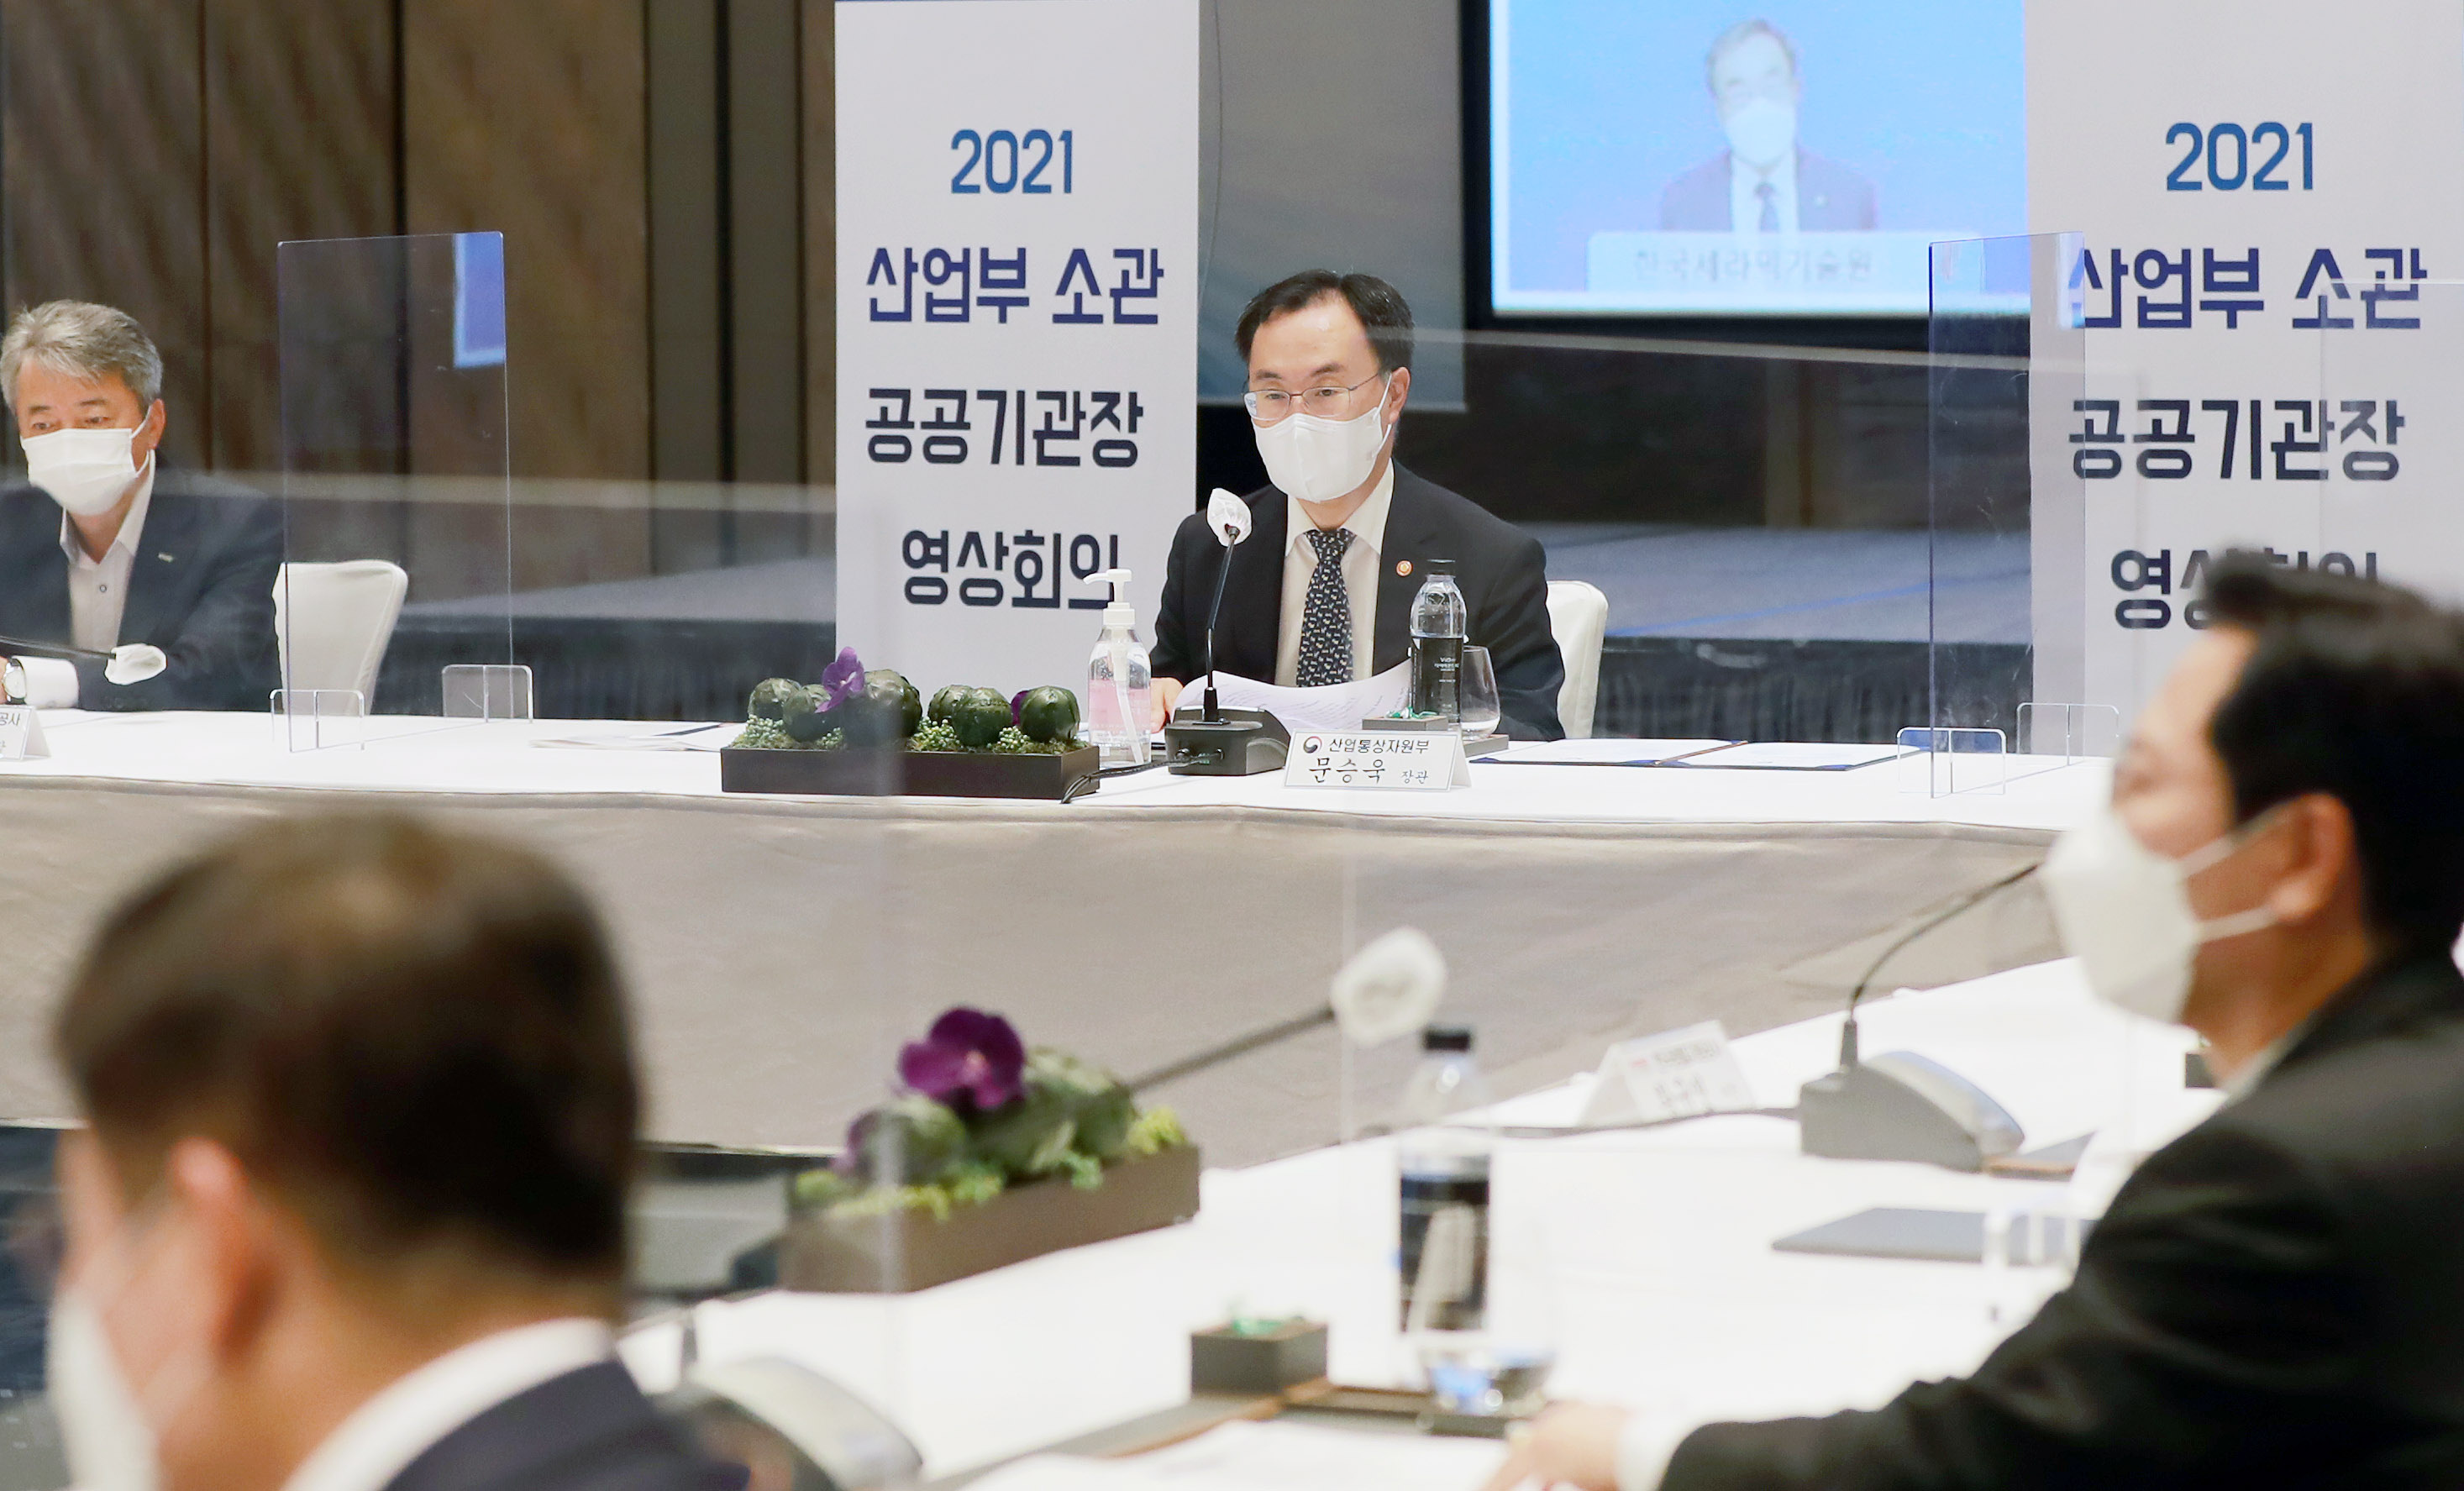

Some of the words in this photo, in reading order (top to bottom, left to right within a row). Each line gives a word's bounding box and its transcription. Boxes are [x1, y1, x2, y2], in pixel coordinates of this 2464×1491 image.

[951, 129, 1073, 194] 2021
[2165, 121, 2314, 192] 2021
[866, 247, 1031, 324] 산업부
[1052, 248, 1164, 325] 소관
[2068, 247, 2265, 330] 산업부
[2292, 248, 2428, 330] 소관
[865, 387, 1144, 469] 공공기관장
[2068, 399, 2406, 481] 공공기관장
[901, 529, 1119, 611] 영상회의
[1309, 757, 1386, 785] 문승욱
[1400, 769, 1429, 785] 장관
[1329, 738, 1430, 754] 산업통상자원부
